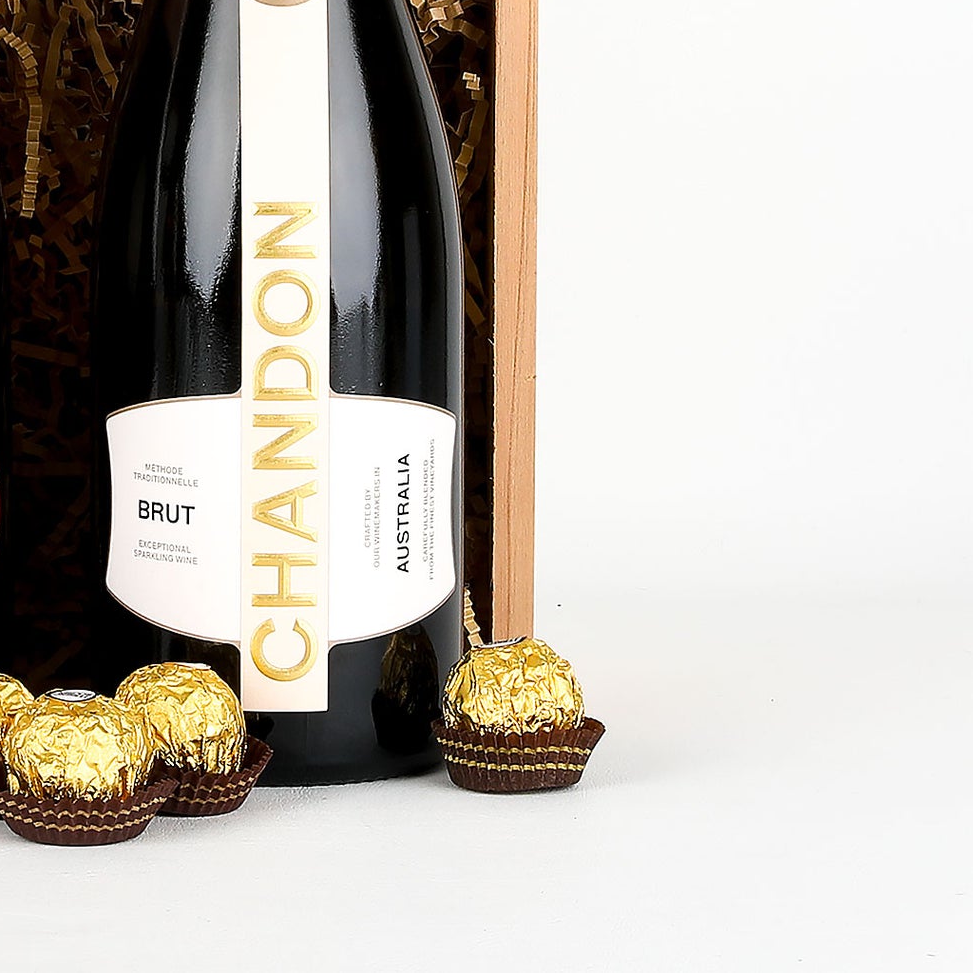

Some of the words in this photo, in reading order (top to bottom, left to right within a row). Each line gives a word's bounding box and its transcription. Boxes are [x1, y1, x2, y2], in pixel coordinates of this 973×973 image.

[250, 202, 321, 682] CHANDON
[373, 466, 380, 477] IN
[138, 499, 195, 525] BRUT
[397, 453, 410, 573] AUSTRALIA
[133, 548, 174, 563] SPARKLING
[175, 555, 199, 565] WINE
[138, 539, 192, 554] EXCEPTIONAL
